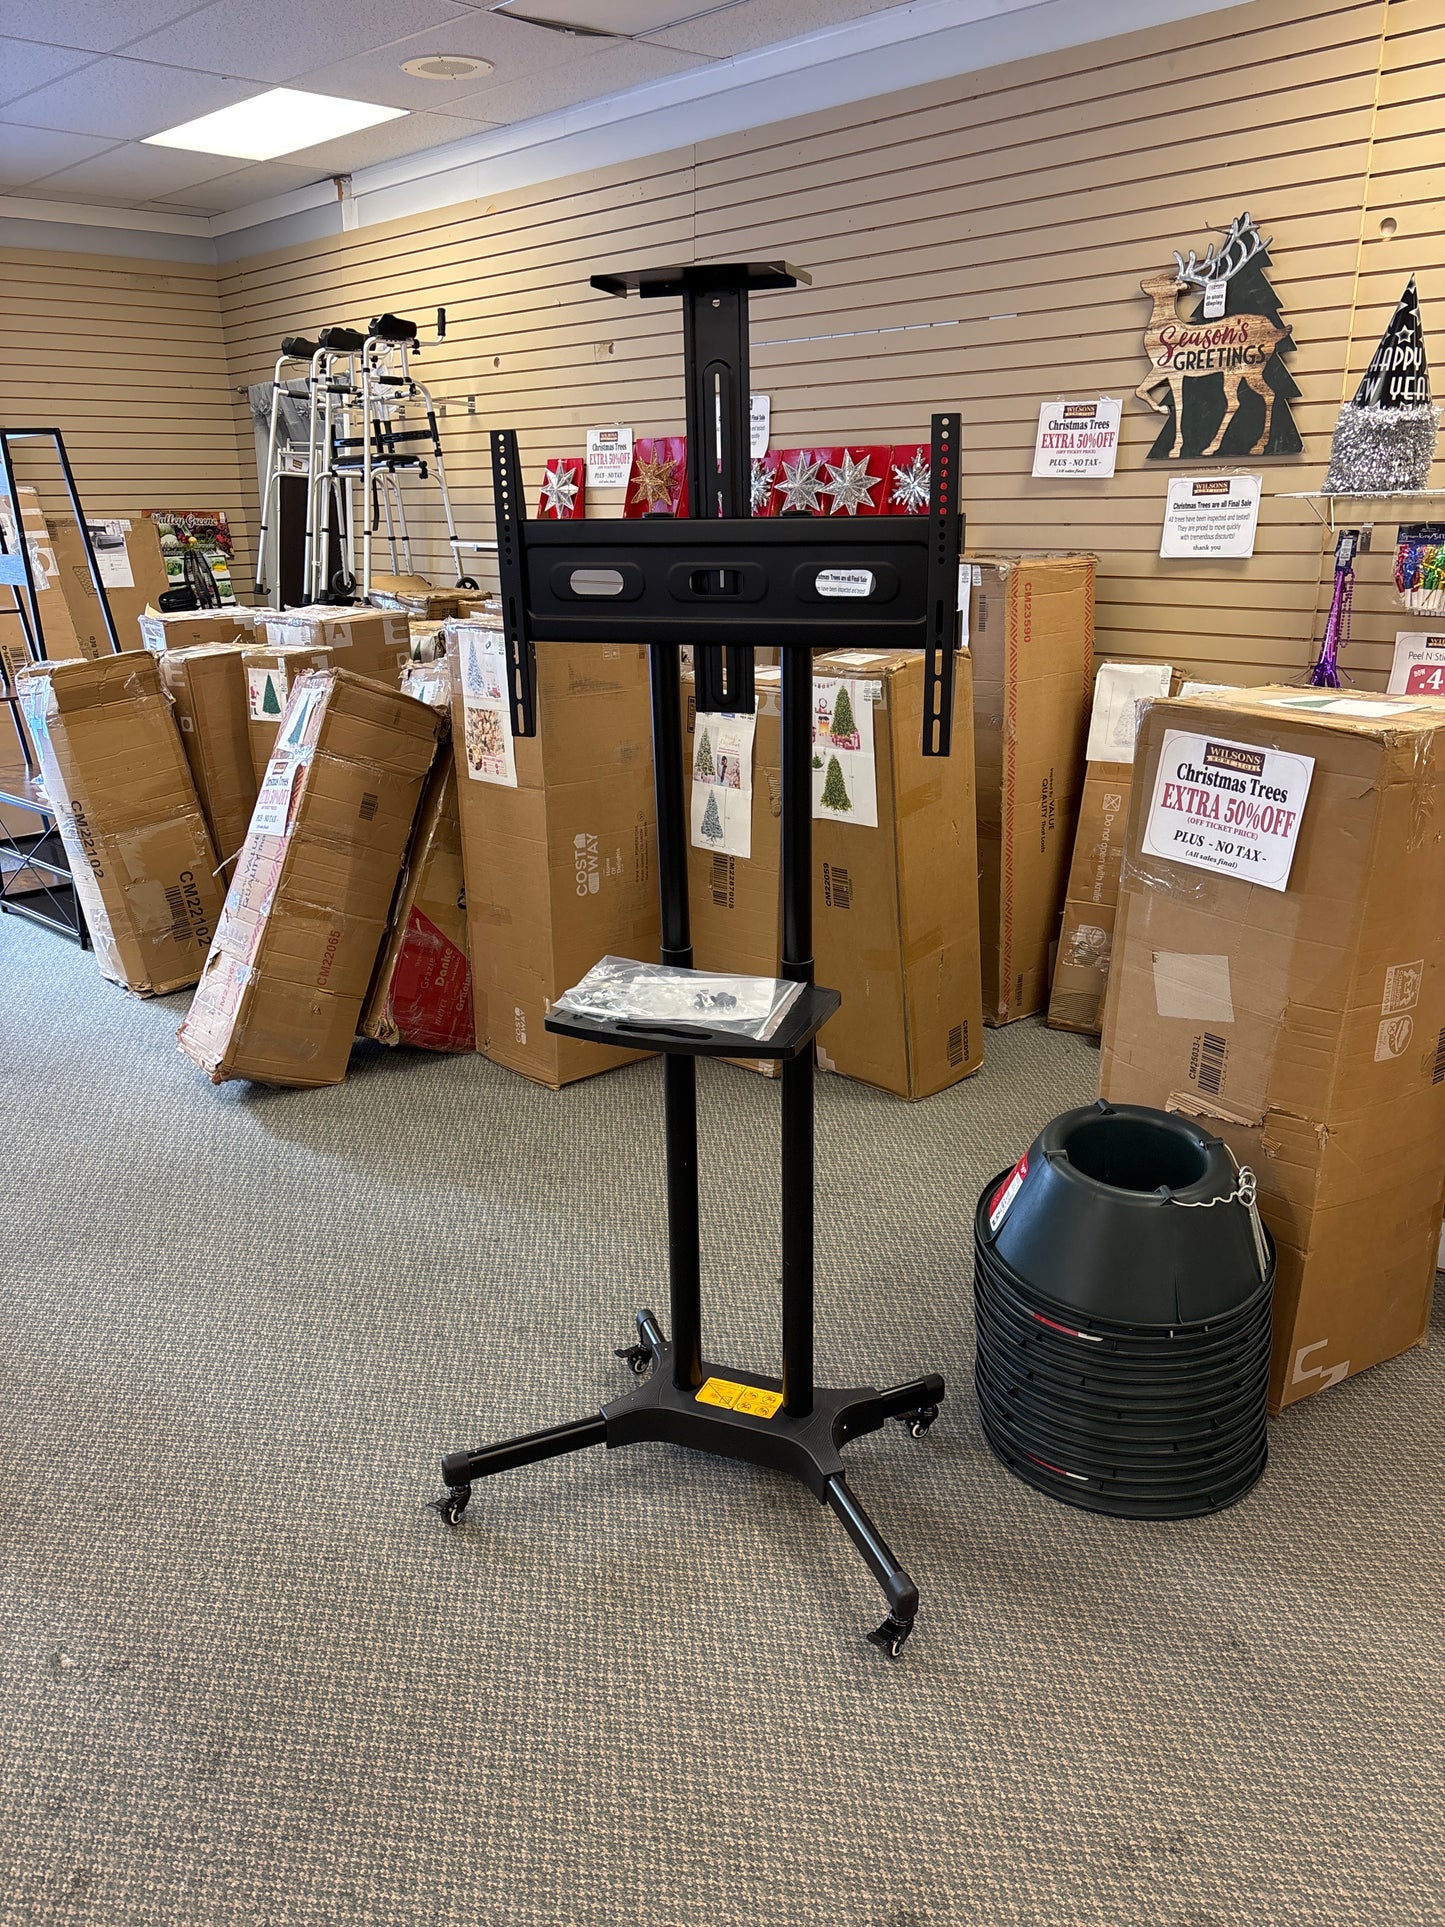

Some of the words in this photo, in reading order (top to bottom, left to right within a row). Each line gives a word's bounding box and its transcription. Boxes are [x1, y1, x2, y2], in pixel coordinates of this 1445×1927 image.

[1156, 318, 1249, 367] Season's
[1173, 344, 1267, 371] GREETINGS
[1370, 346, 1422, 372] HAPPY
[1041, 433, 1075, 449] EXTRA
[1076, 431, 1115, 449] 50%OFF
[1048, 420, 1088, 430] Christmas
[1089, 419, 1110, 429] Trees
[590, 453, 608, 465] EXTRA
[151, 513, 185, 528] Valley
[185, 513, 218, 528] Greene
[1173, 502, 1196, 510] Christmas
[1241, 499, 1252, 507] Sale
[1023, 582, 1032, 643] CM23590
[1408, 651, 1424, 660] Peel
[1426, 652, 1432, 660] N
[1209, 746, 1262, 765] WILSONS
[1041, 778, 1049, 818] QUALITY
[1176, 762, 1247, 794] Christmas
[1249, 778, 1288, 803] Trees
[1104, 814, 1114, 826] Do
[1160, 782, 1220, 820] EXTRA
[1223, 798, 1296, 838] 50%OFF
[70, 800, 105, 879] CM22102
[1102, 828, 1111, 841] not
[1173, 829, 1205, 847] PLUS
[1215, 840, 1234, 855] NO
[1237, 845, 1261, 862] TAX
[1187, 816, 1204, 827] (OFF
[1205, 821, 1233, 833] TICKET
[1233, 828, 1258, 841] PRICE)
[244, 834, 260, 874] VALUE
[586, 833, 599, 872] WAY
[1099, 842, 1108, 862] open
[1185, 849, 1199, 859] (All
[1199, 853, 1216, 863] sales
[1216, 857, 1238, 869] final)
[243, 854, 260, 908] QUALITY
[575, 850, 588, 896] COST
[823, 862, 832, 907] CM22059
[1095, 864, 1105, 881] with
[179, 870, 212, 947] CM22102
[317, 930, 342, 986] CM22065
[435, 948, 453, 987] Danke
[1383, 970, 1393, 1011] CAUTION
[1188, 1035, 1201, 1080] CM25033-L
